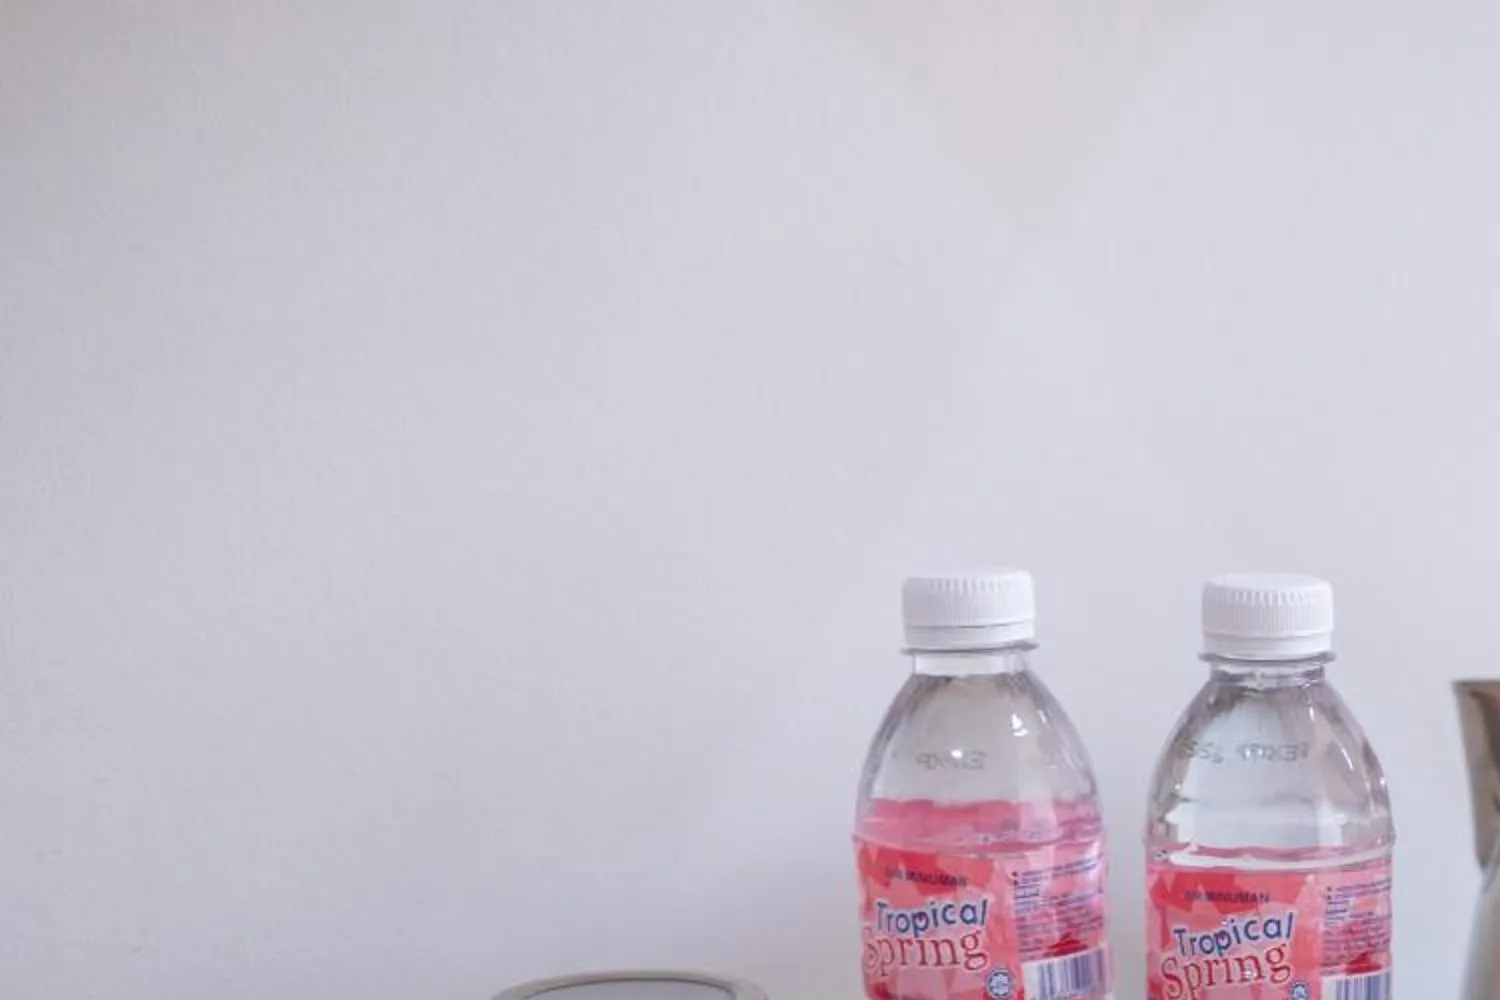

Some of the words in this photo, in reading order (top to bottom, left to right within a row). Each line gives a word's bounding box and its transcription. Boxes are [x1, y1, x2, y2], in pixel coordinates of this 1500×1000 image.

[876, 898, 989, 938] Tropical
[1173, 911, 1294, 956] Tropical
[864, 926, 989, 977] Spring
